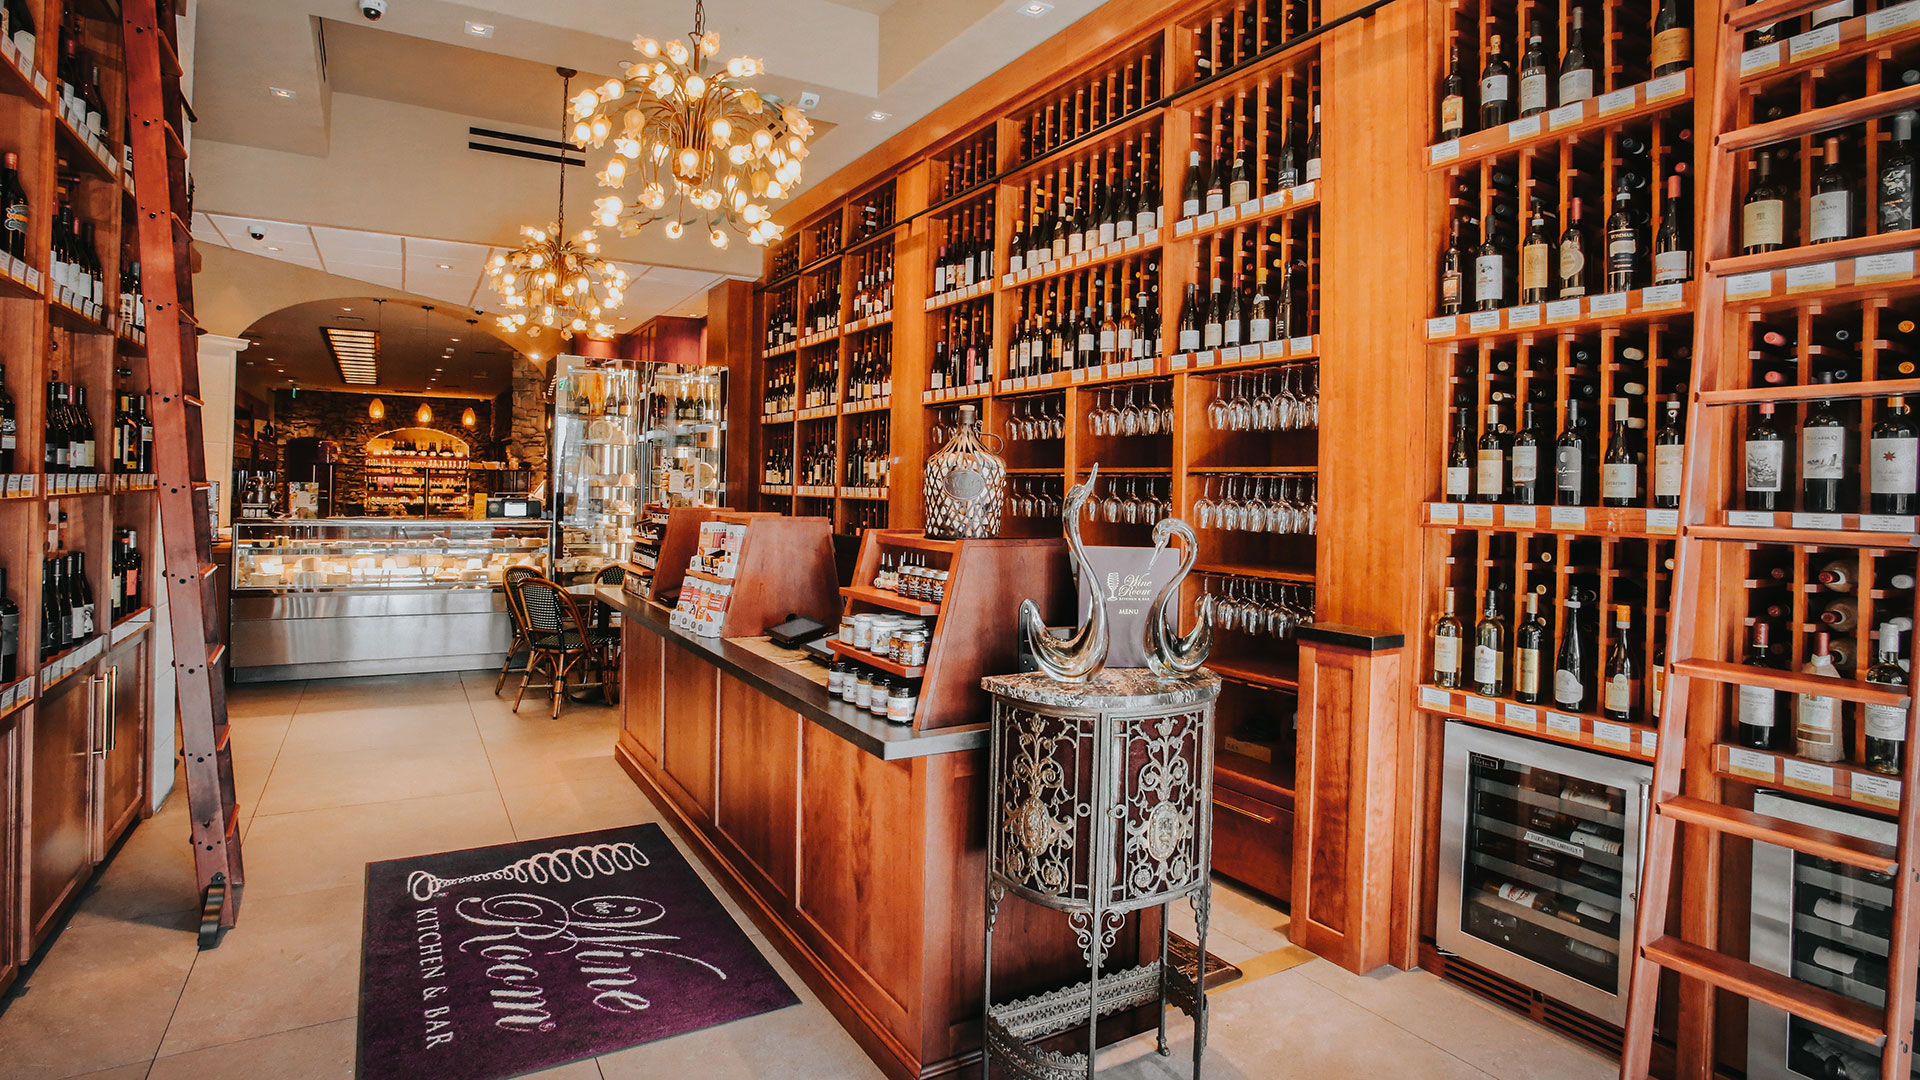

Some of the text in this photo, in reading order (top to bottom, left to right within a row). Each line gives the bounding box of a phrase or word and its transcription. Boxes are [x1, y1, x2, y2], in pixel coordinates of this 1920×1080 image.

[1118, 585, 1152, 597] Room
[1124, 573, 1152, 587] Wine
[416, 907, 454, 1050] KITCHEN & BAR
[456, 893, 578, 1031] Room
[555, 895, 727, 1013] Wine
